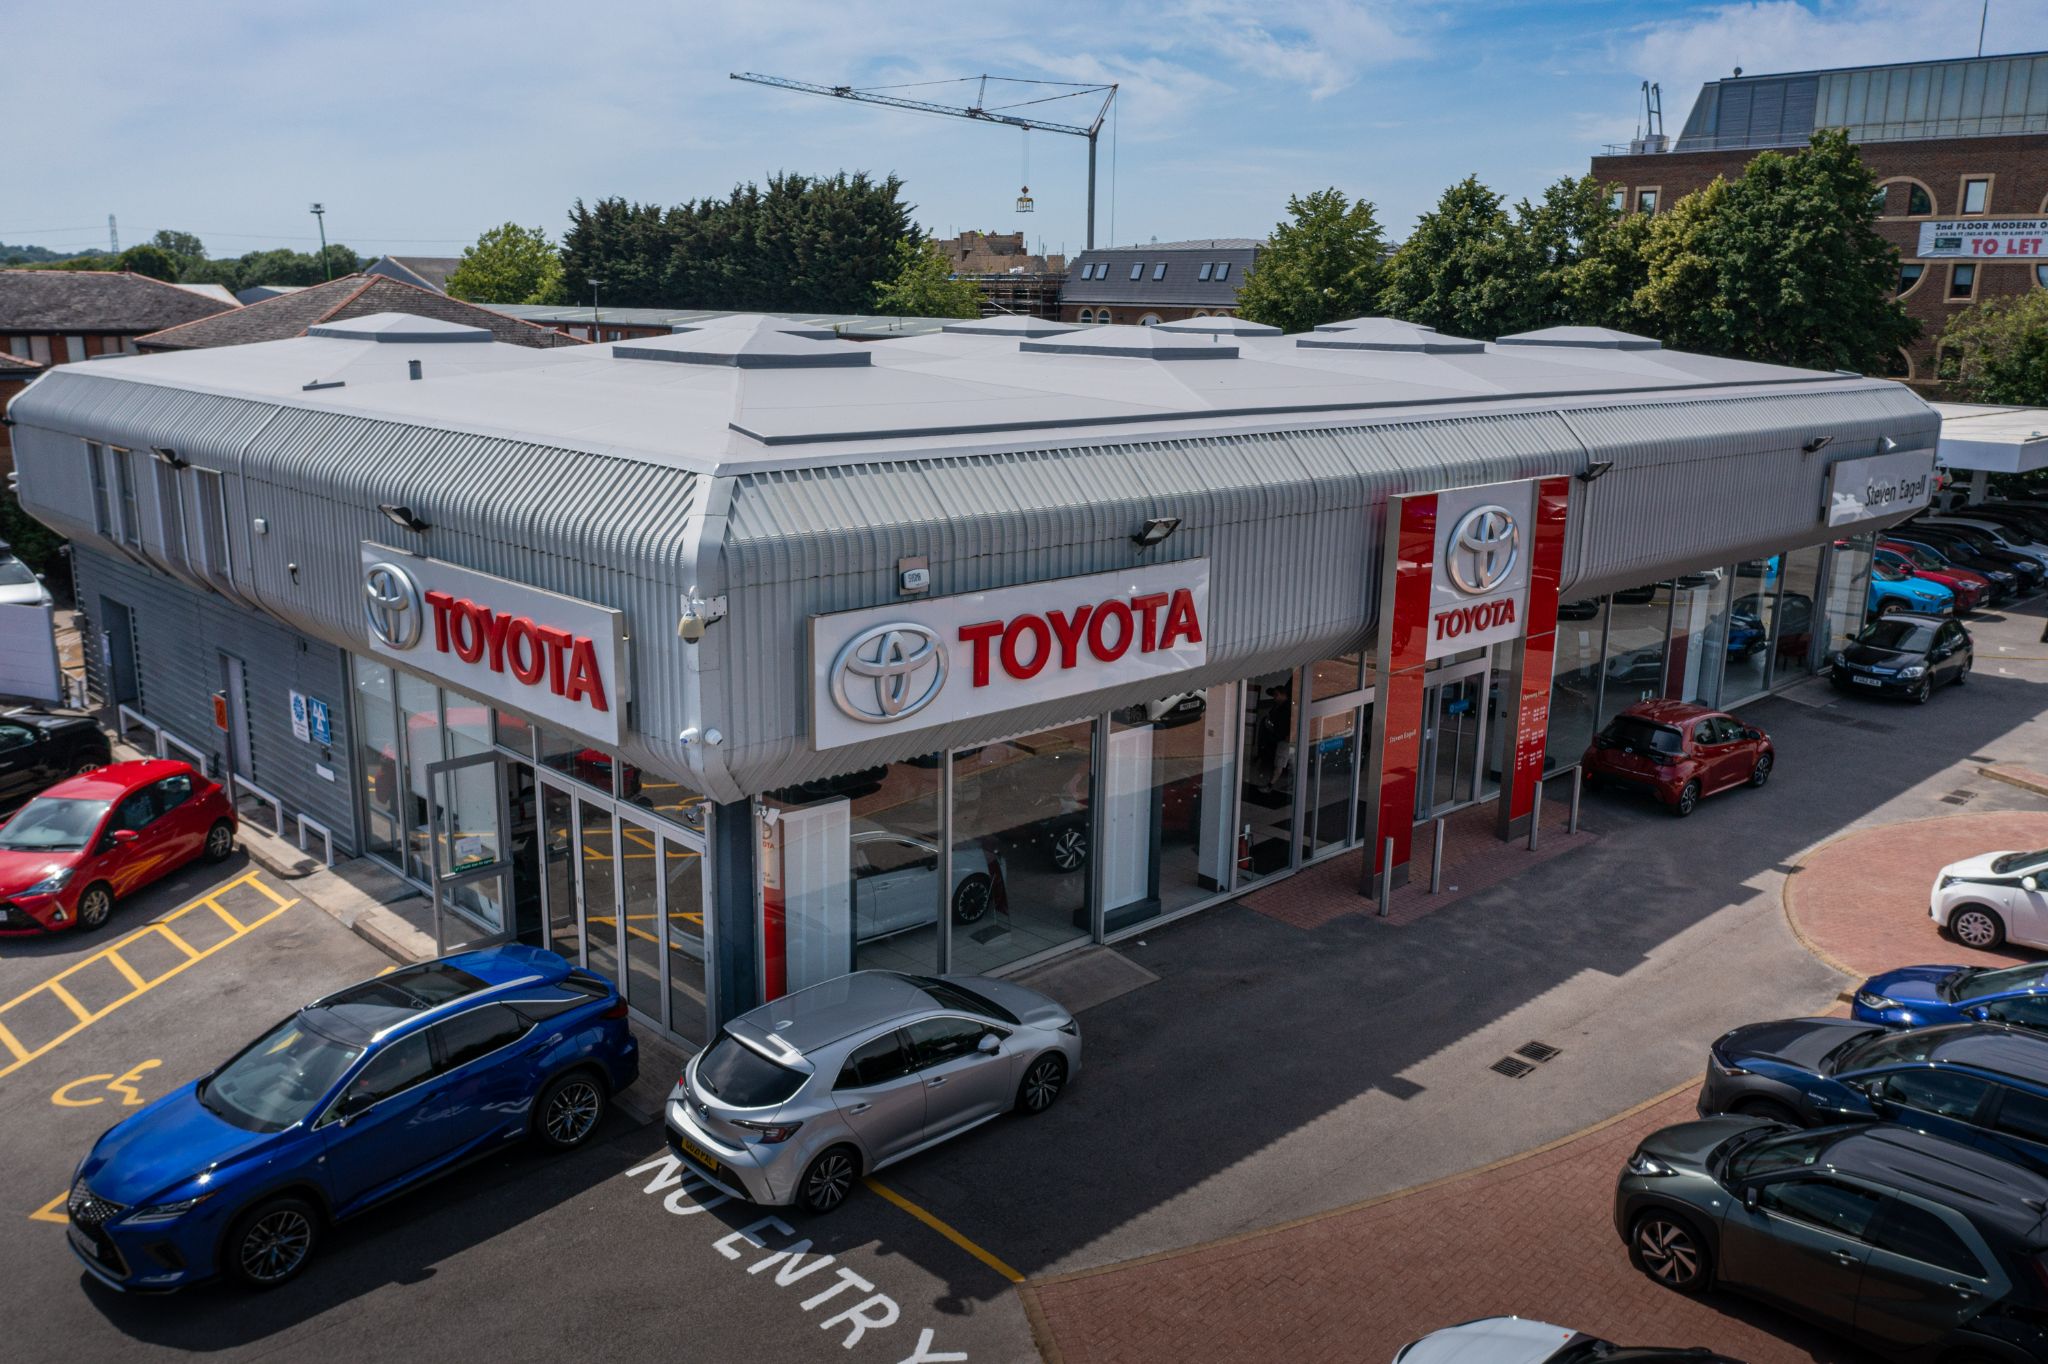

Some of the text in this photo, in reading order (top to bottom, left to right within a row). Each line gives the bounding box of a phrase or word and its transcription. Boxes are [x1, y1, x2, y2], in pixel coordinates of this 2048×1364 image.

[1956, 222, 1989, 230] FLOOR
[1971, 238, 1999, 255] TO
[2006, 238, 2043, 255] LET
[1865, 474, 1926, 507] Steven Eagell
[958, 588, 1203, 688] TOYOTA
[1435, 597, 1516, 641] TOYOTA
[425, 590, 609, 712] TOYOTA
[625, 1154, 735, 1215] NO
[712, 1215, 968, 1364] ENTRY
